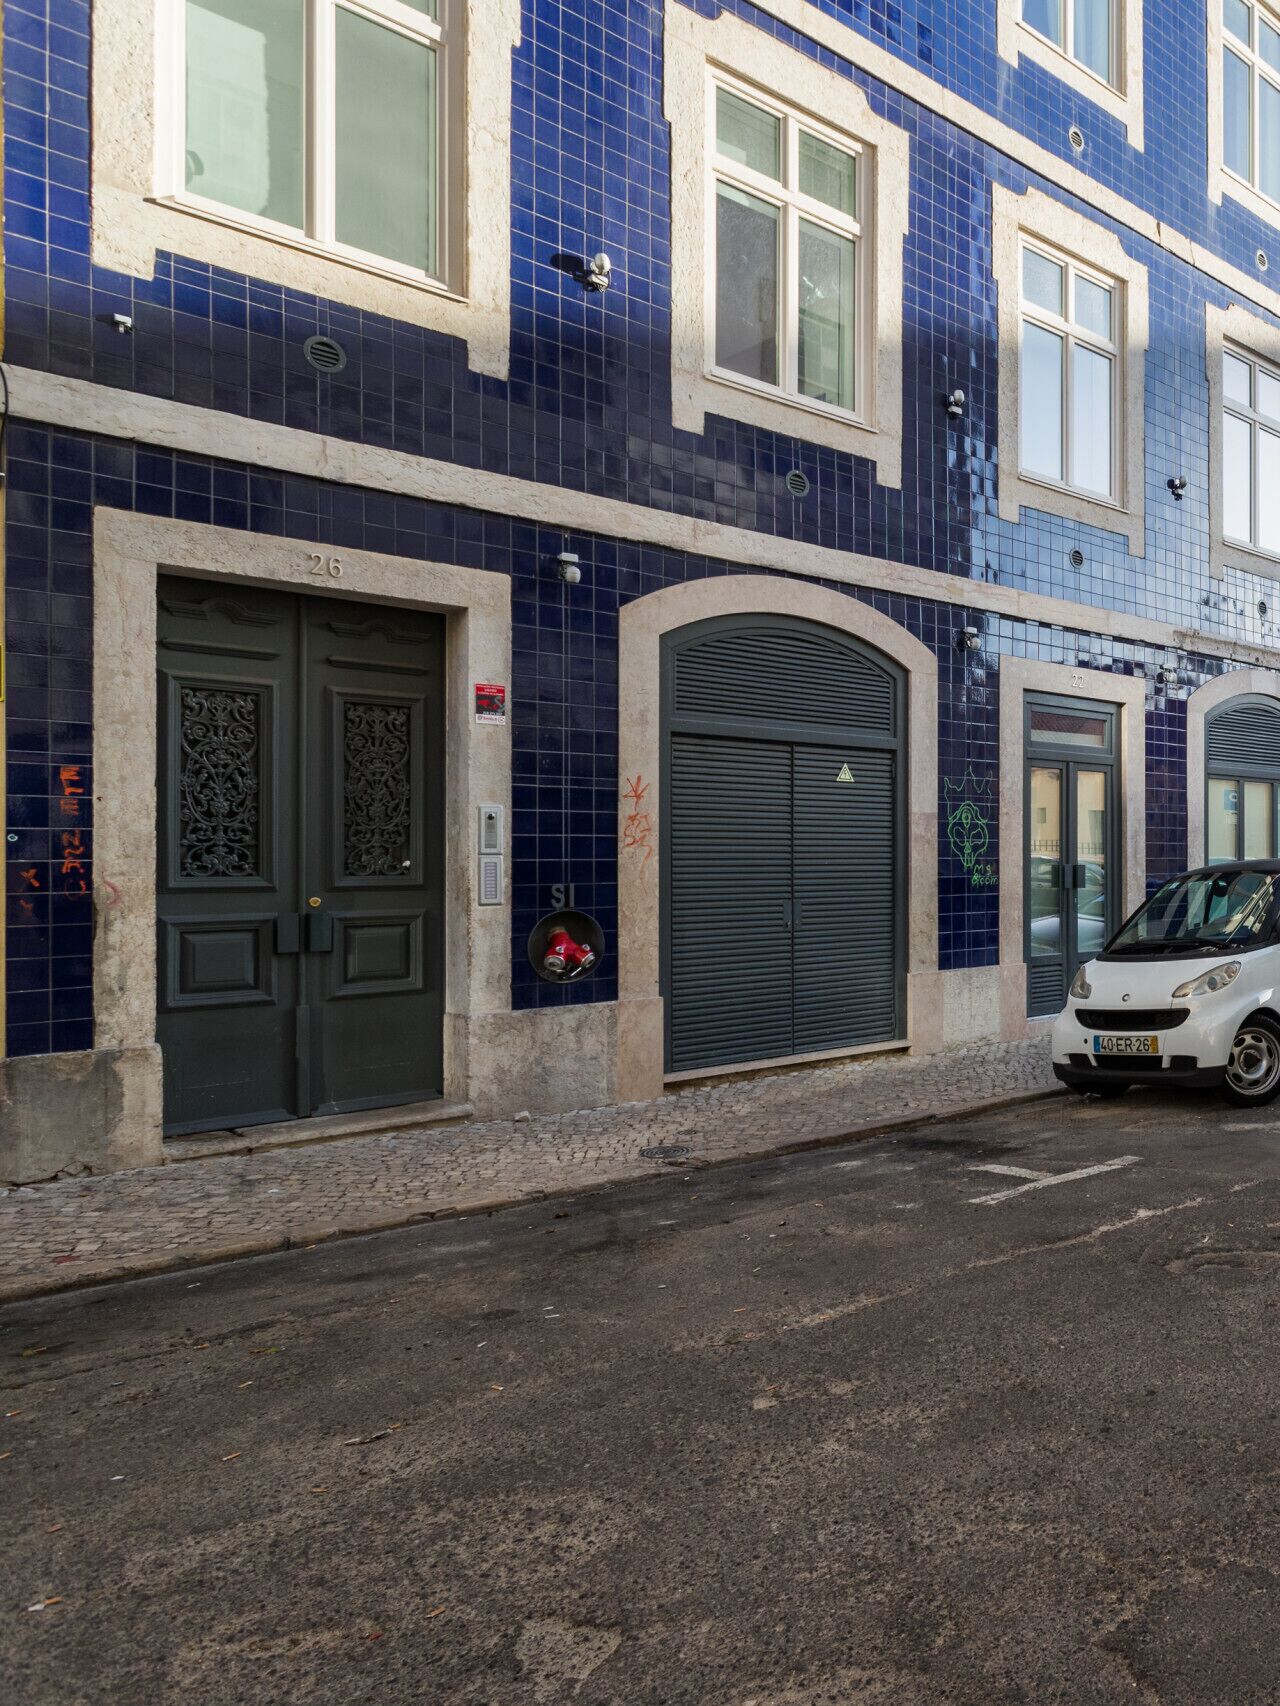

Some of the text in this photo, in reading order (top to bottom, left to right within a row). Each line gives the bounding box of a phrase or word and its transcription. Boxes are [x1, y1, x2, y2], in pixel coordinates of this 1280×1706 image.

[311, 554, 343, 578] 26
[1072, 673, 1084, 688] 22
[551, 883, 575, 908] SI
